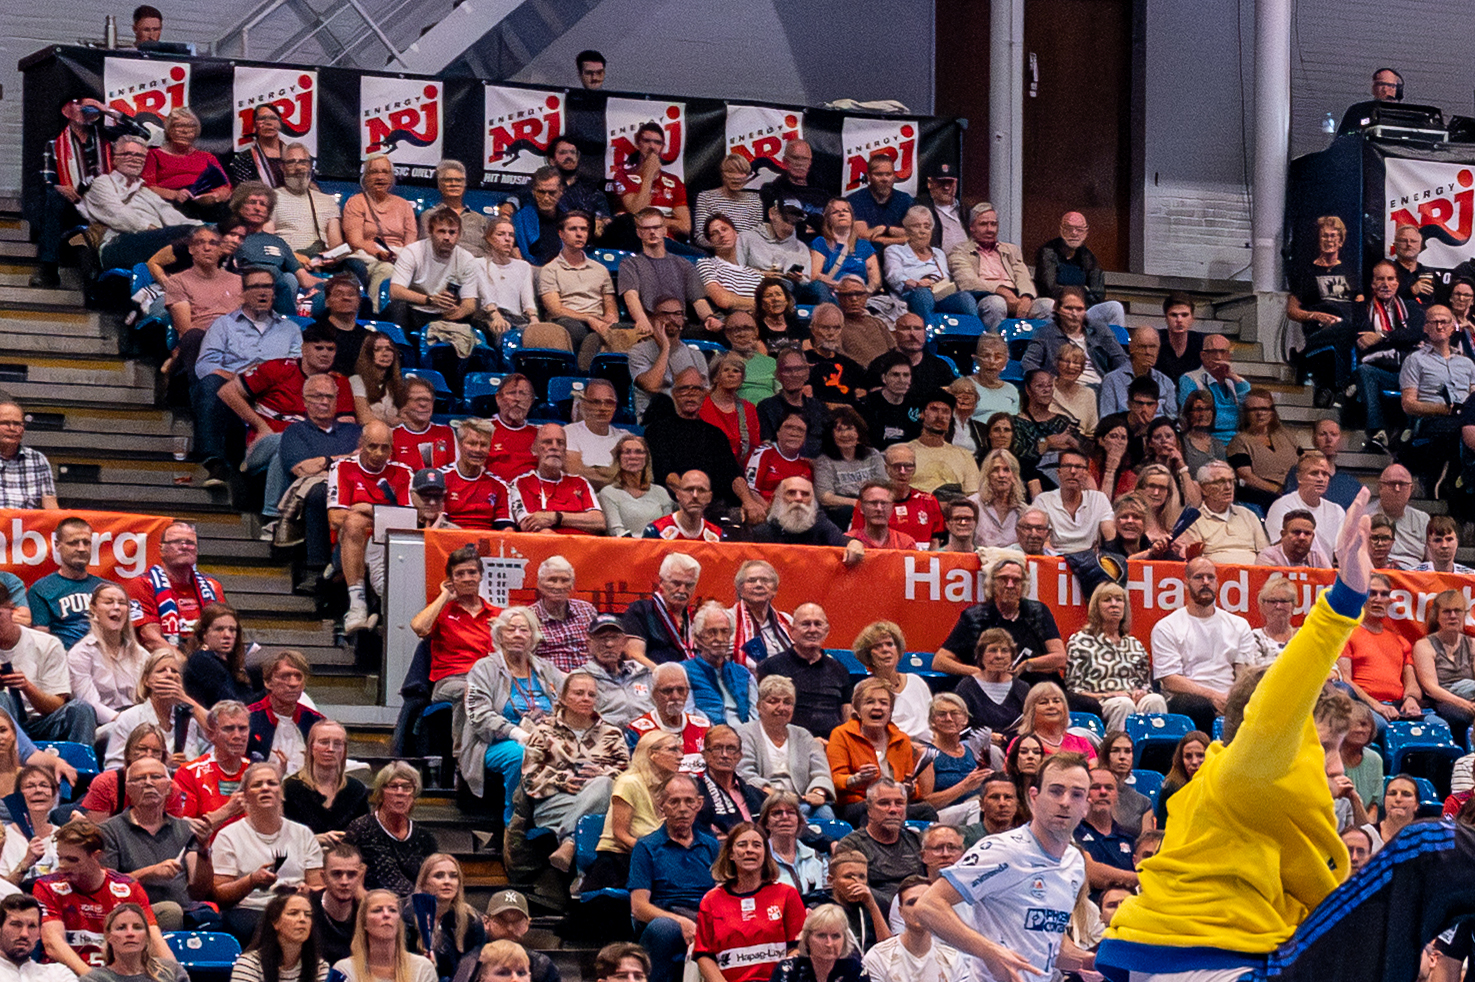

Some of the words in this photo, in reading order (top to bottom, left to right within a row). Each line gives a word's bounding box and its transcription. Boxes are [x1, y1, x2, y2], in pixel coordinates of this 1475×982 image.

[364, 85, 439, 154] NRJ
[365, 96, 422, 116] ENERGY
[491, 95, 560, 166] NRJ
[1390, 183, 1455, 208] ENERGY
[1126, 565, 1249, 613] Had
